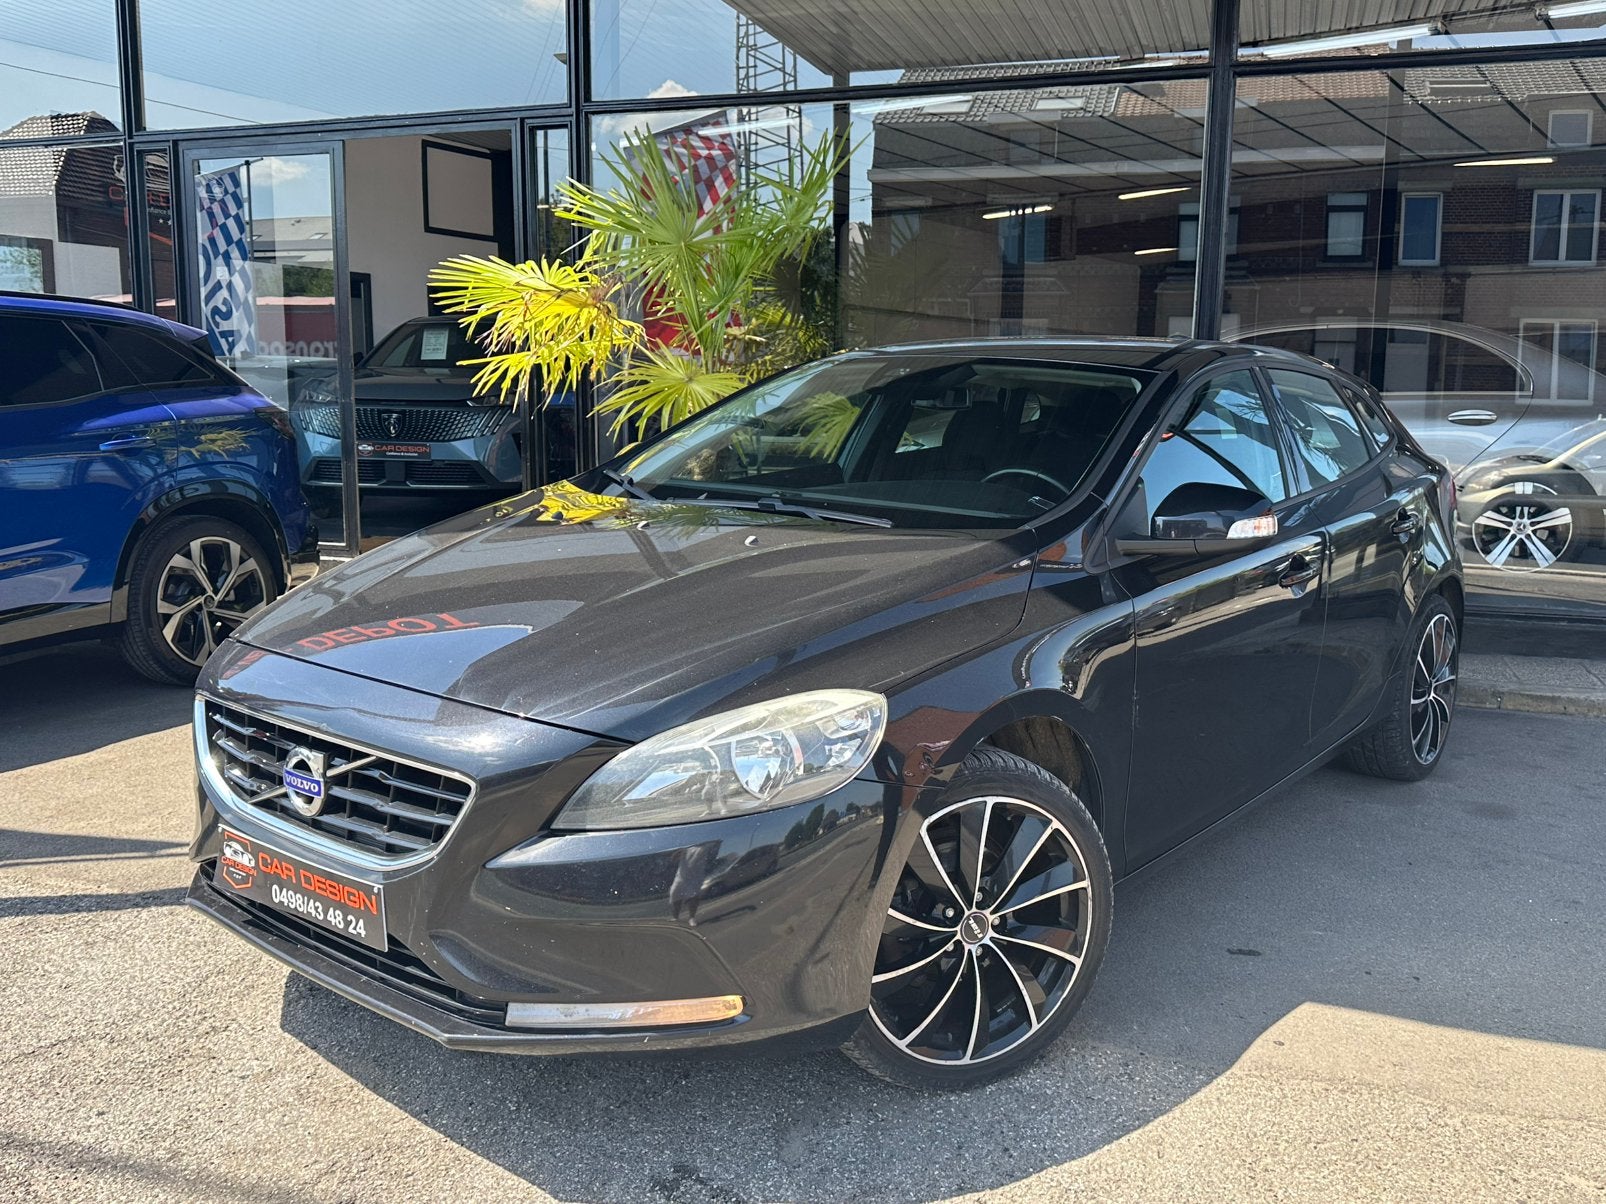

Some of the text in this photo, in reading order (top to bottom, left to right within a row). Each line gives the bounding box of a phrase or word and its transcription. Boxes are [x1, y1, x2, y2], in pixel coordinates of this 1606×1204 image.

[285, 773, 319, 792] VOLVO
[221, 855, 235, 867] CAR
[235, 861, 257, 877] DESIGN
[258, 852, 378, 915] CAR DESIGN
[271, 884, 366, 938] 0498/43 48 24
